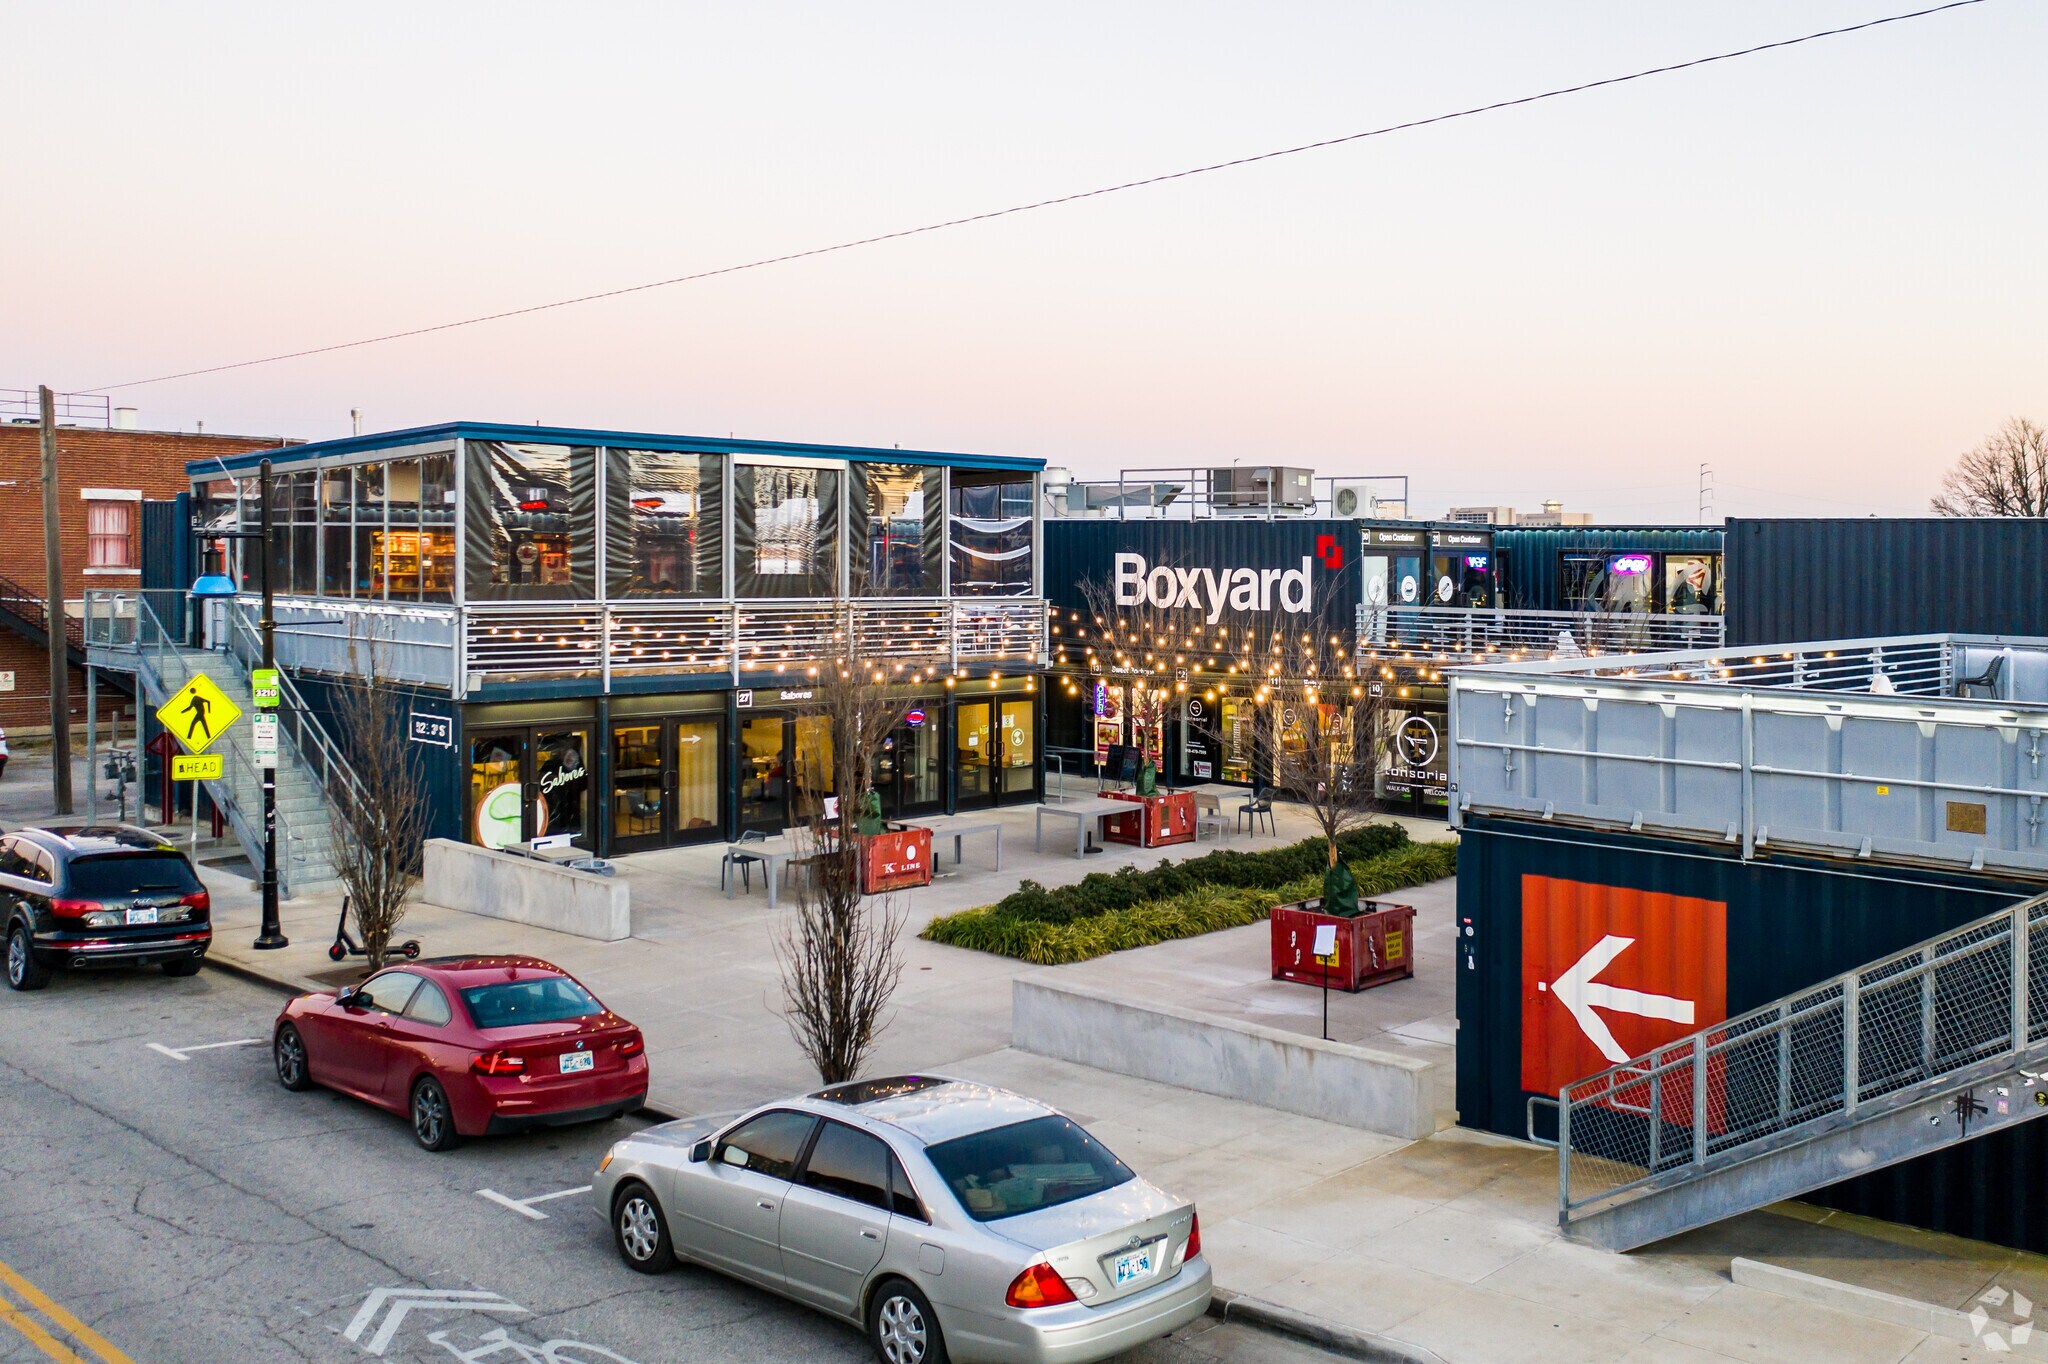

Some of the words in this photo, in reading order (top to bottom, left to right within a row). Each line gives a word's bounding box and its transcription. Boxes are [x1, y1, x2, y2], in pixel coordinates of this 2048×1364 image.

[1379, 532, 1392, 542] Open
[1393, 533, 1415, 541] Container
[1448, 535, 1460, 544] Open
[1461, 535, 1481, 543] Container
[1115, 552, 1312, 625] Boxyard
[256, 689, 277, 697] 3210
[780, 691, 813, 700] Sabores
[739, 693, 750, 703] 27
[1385, 766, 1448, 781] tonsoria
[1385, 784, 1410, 793] WALK-INS
[1423, 788, 1449, 797] WELCOM
[901, 862, 921, 871] LINE
